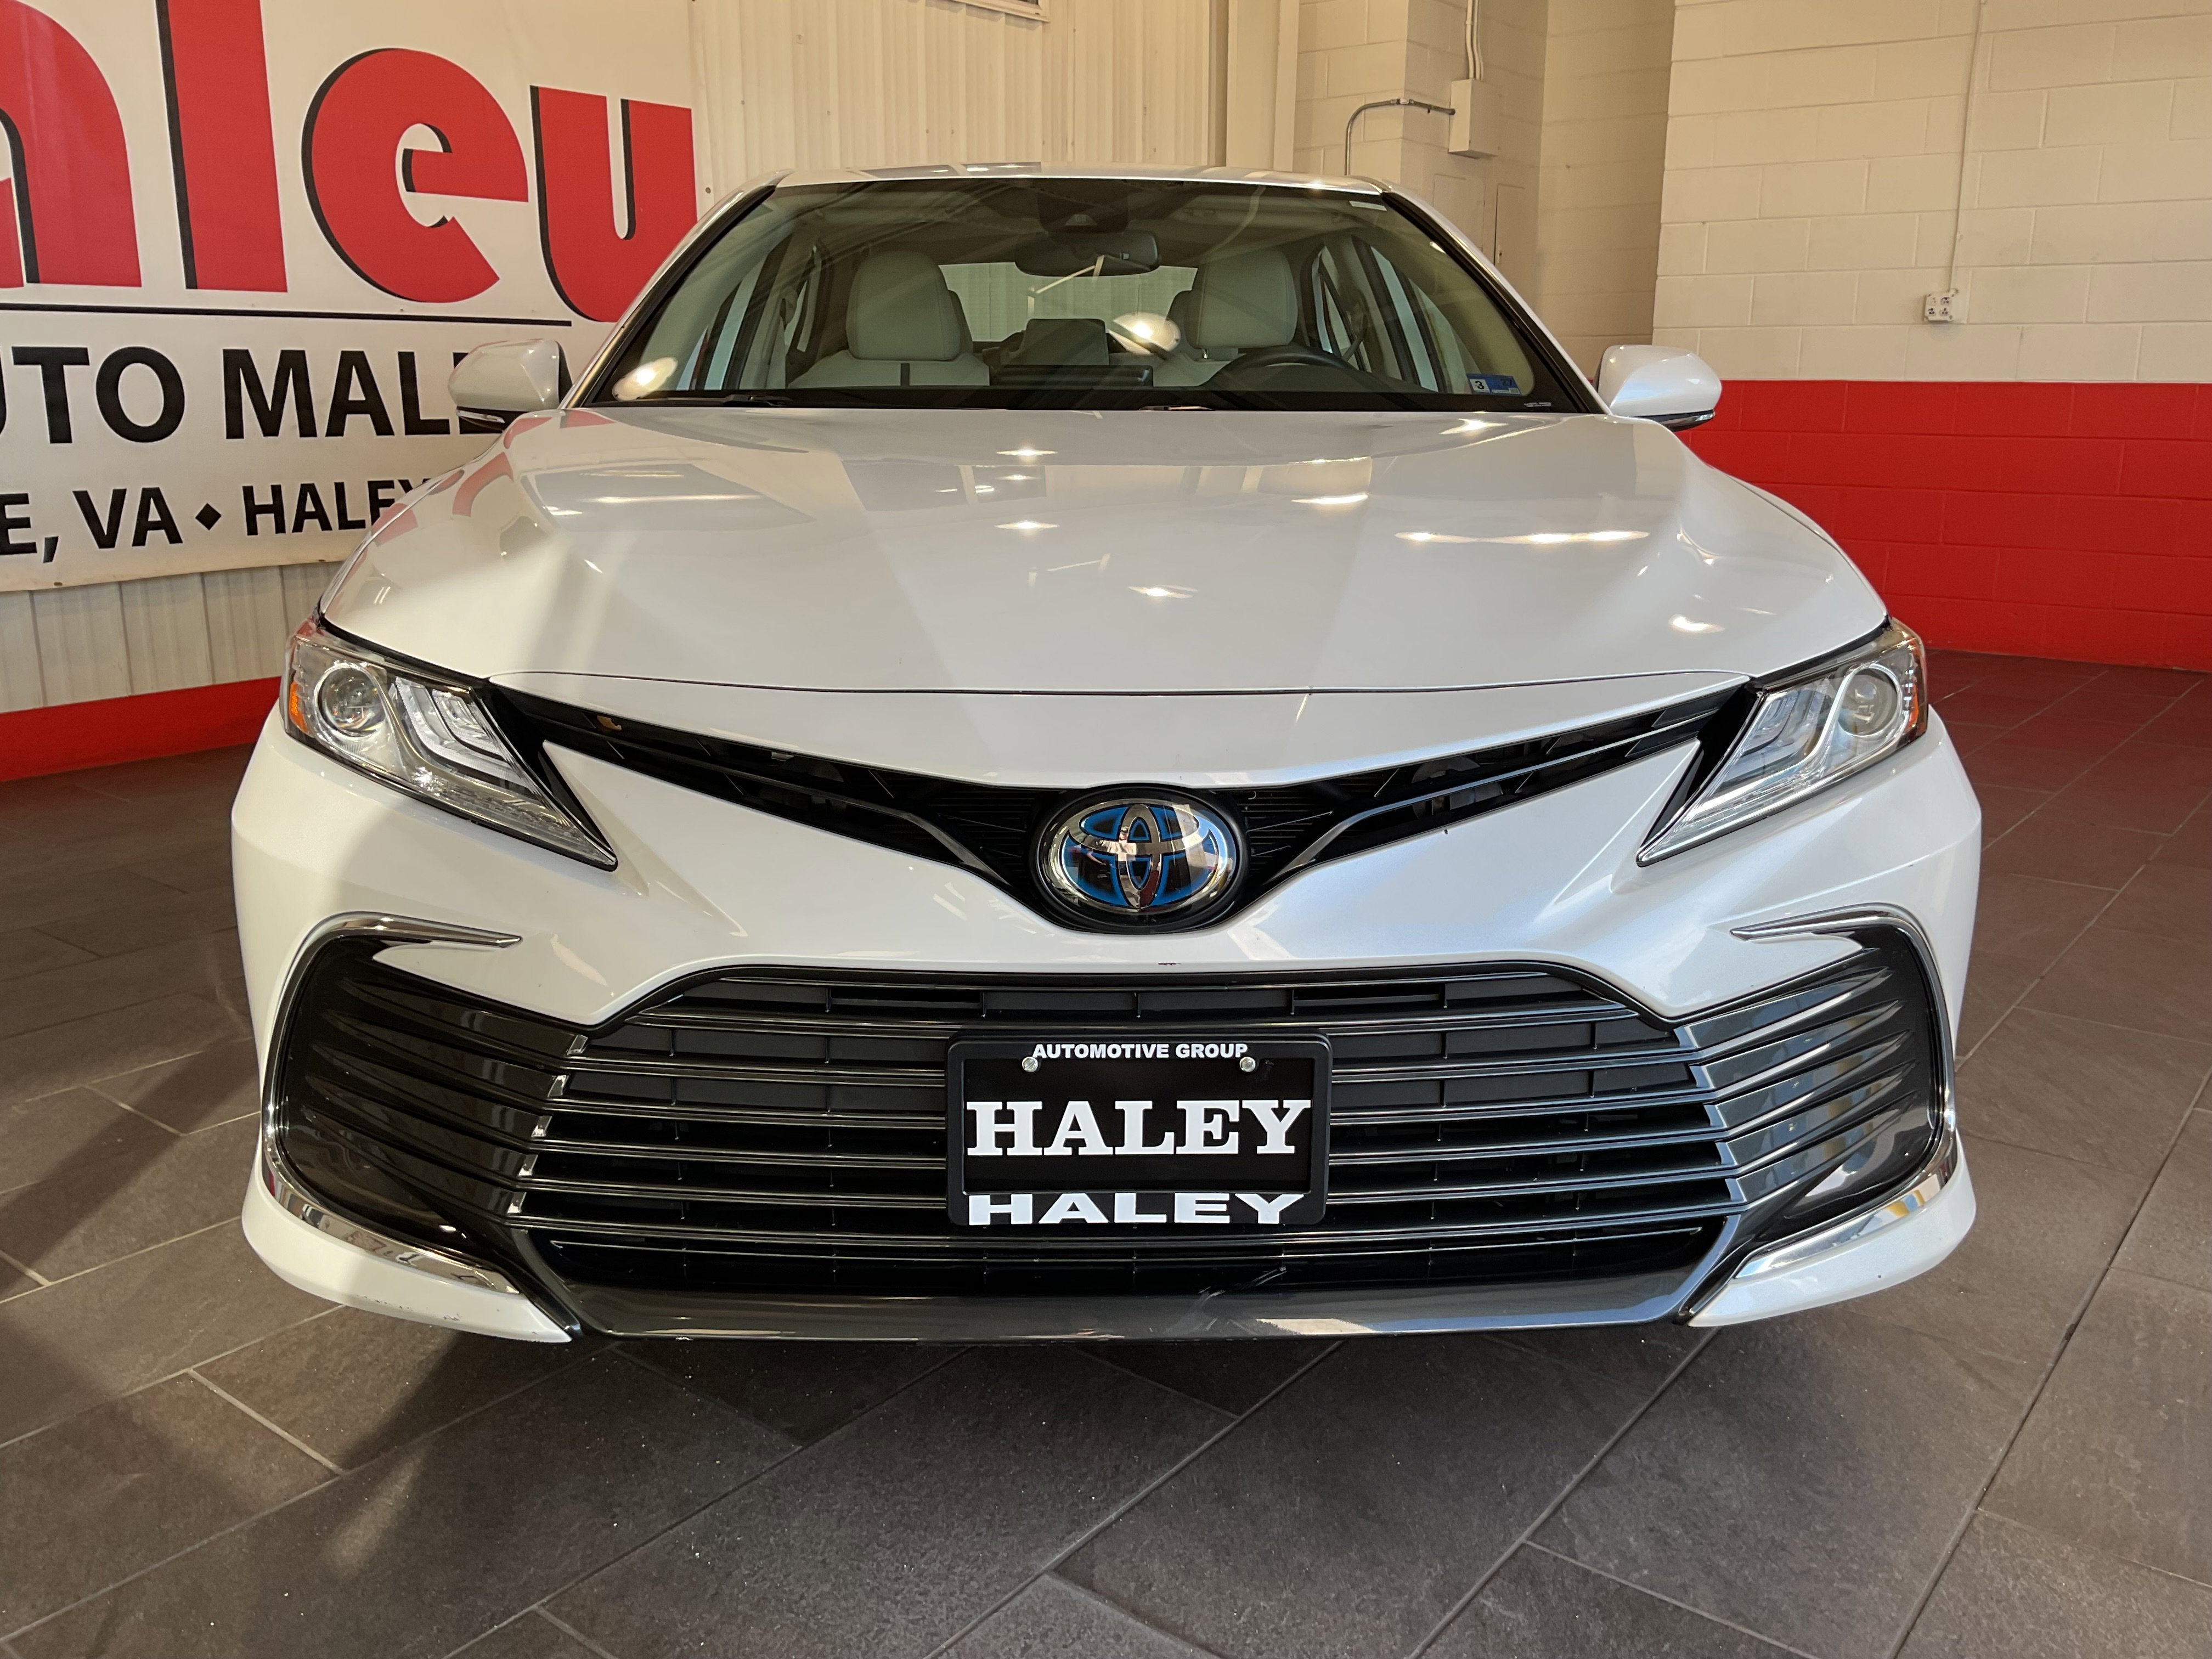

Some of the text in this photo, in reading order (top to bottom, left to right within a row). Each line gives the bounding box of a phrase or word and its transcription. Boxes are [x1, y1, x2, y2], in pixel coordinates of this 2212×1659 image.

[0, 346, 185, 443] TO
[1475, 381, 1485, 390] 3
[72, 487, 183, 549] VA
[1032, 1043, 1248, 1059] AUTOMOTIVE GROUP
[966, 1100, 1311, 1156] HALEY
[968, 1193, 1305, 1226] HALEY
